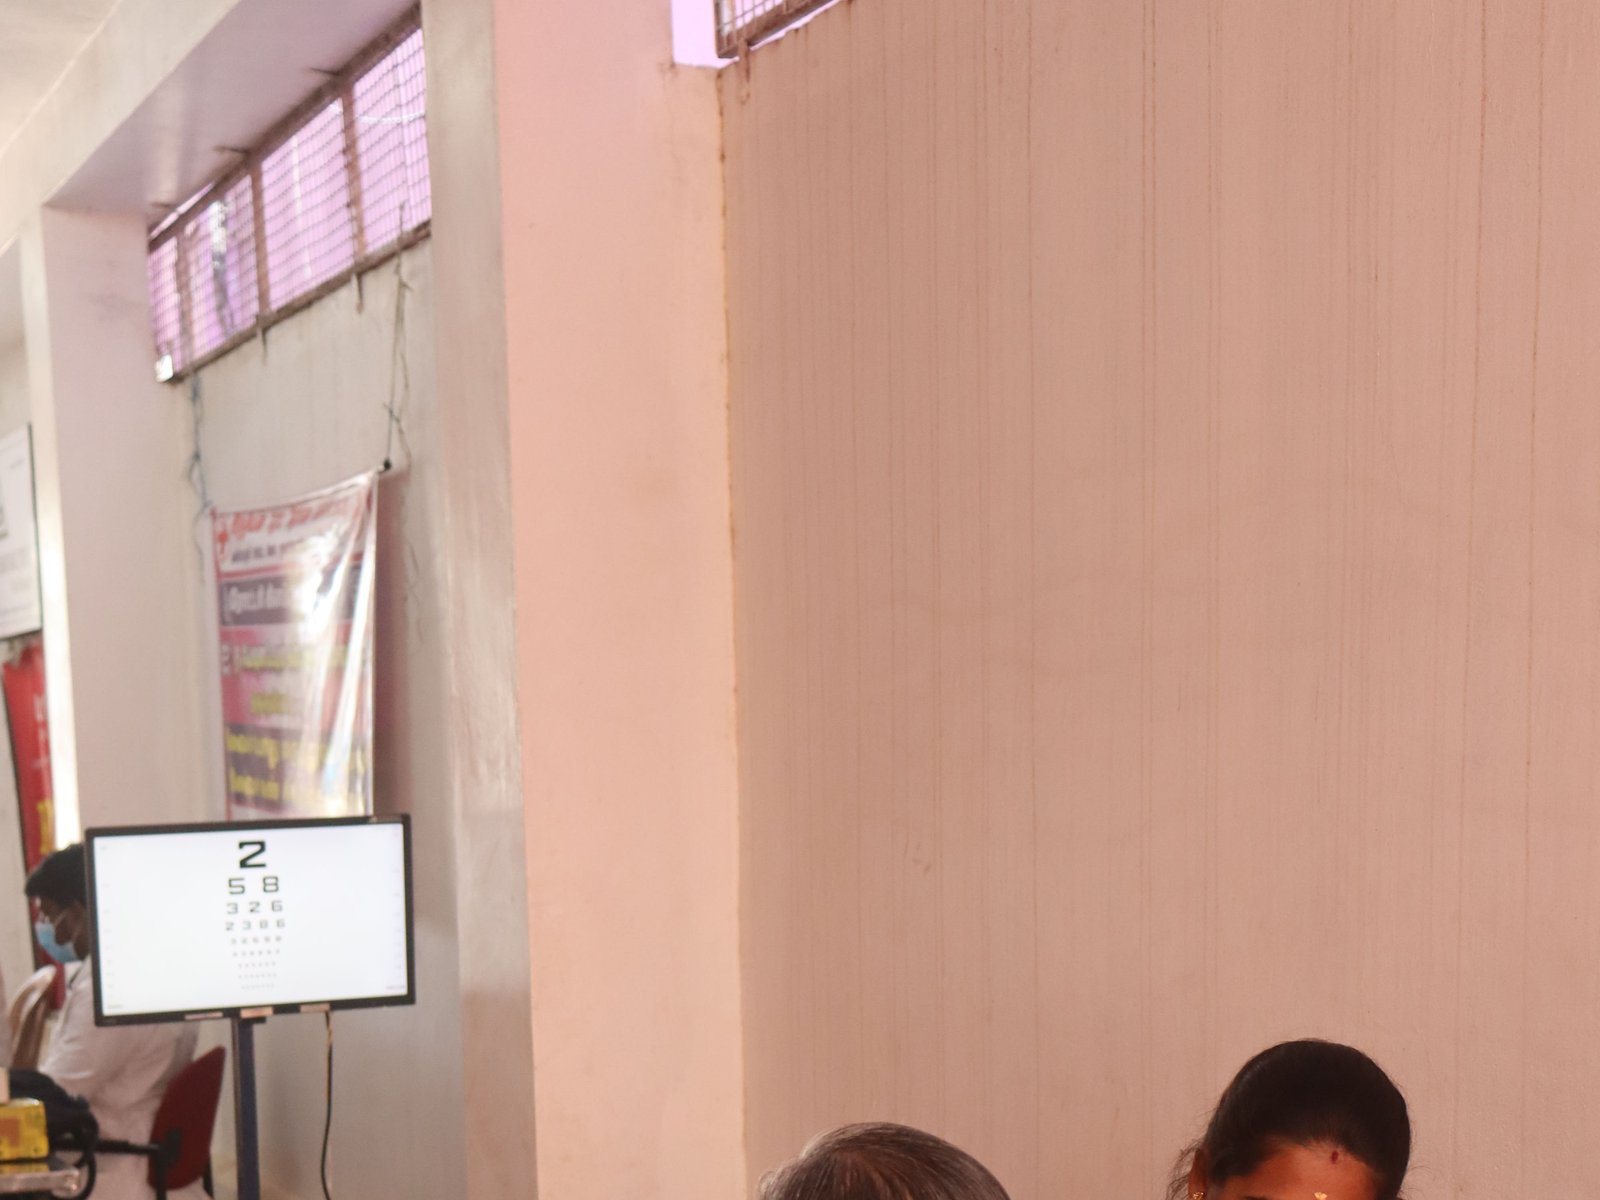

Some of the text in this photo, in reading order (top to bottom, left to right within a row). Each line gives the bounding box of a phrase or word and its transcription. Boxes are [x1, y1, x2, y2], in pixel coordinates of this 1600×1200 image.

[238, 840, 266, 868] 2
[228, 876, 279, 894] 5 8
[226, 902, 238, 915] 3
[249, 901, 260, 913] 2
